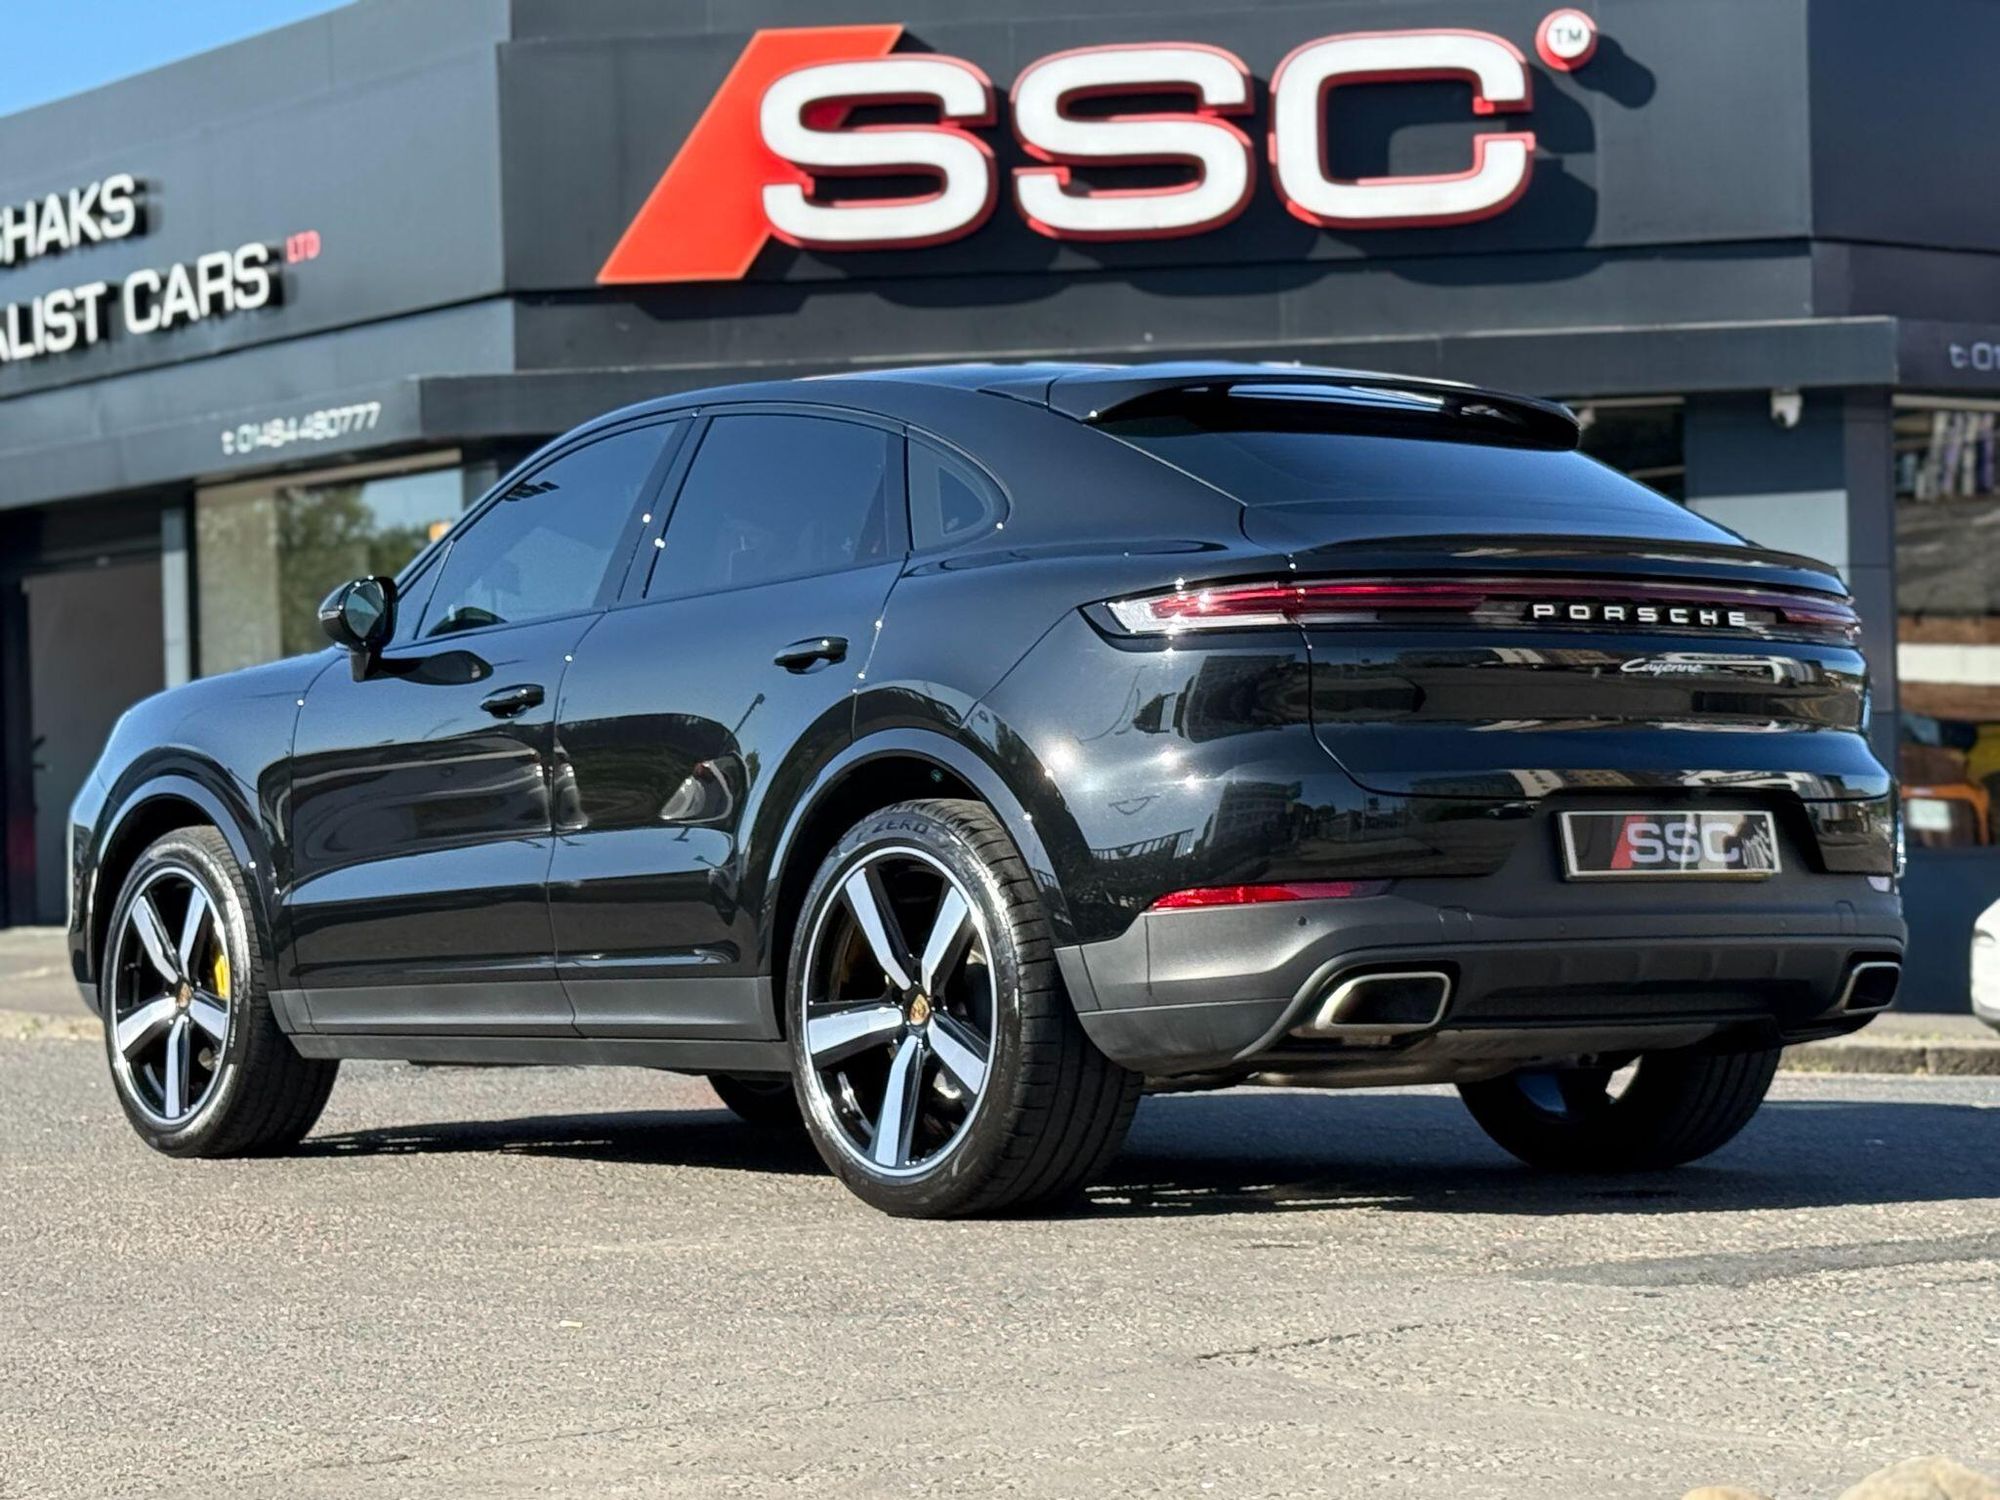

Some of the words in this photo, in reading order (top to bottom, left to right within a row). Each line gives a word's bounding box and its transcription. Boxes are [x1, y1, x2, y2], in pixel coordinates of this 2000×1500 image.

[1556, 28, 1582, 46] TM
[757, 28, 1535, 251] SSC
[0, 173, 136, 264] HAKS
[123, 242, 271, 335] CARS
[1533, 604, 1746, 627] PORSCHE
[1620, 657, 1703, 677] Cayenne
[871, 819, 929, 834] ZERO
[1626, 822, 1740, 864] SSC
